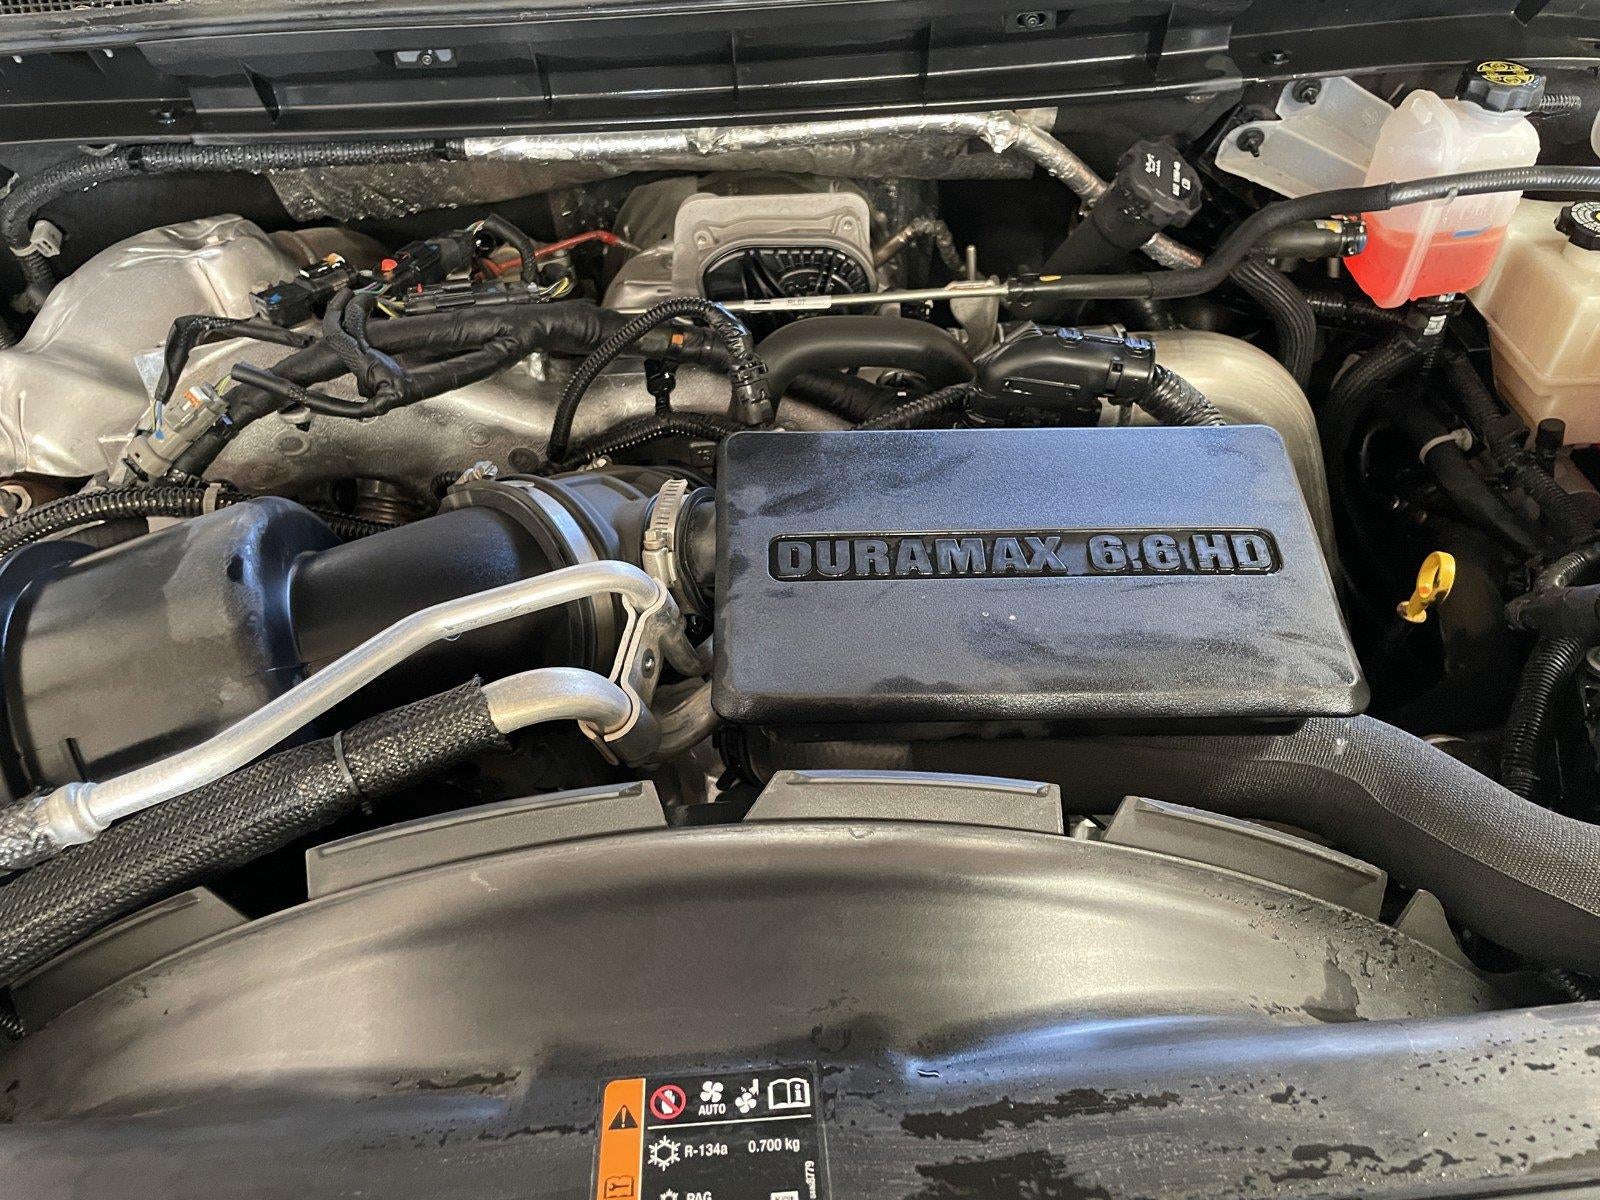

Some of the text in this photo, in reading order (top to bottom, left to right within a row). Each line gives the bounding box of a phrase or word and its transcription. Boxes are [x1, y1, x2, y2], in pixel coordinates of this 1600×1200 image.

[777, 533, 1274, 577] DURAMAX 6.6 HD
[699, 1103, 726, 1115] AUTO
[684, 1138, 800, 1158] R-134a 0.700 kg
[686, 1191, 712, 1200] PAG
